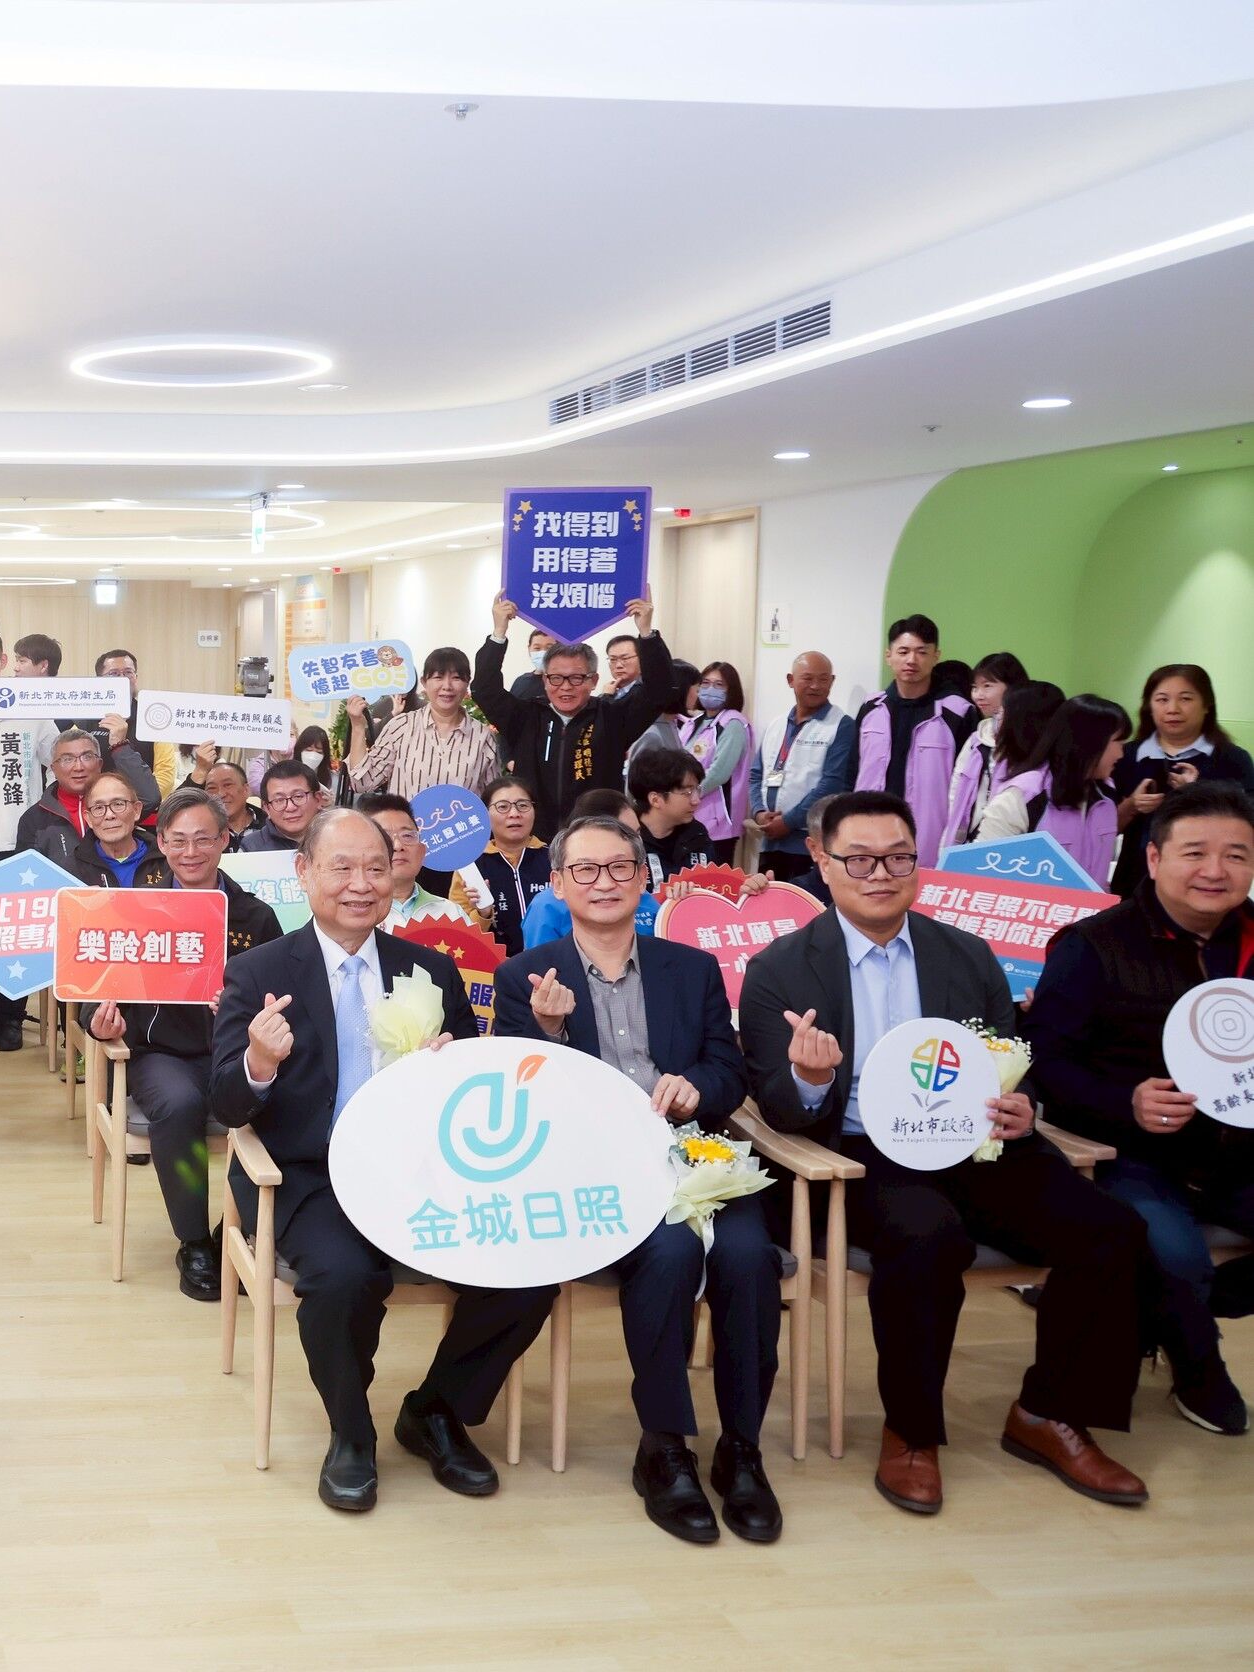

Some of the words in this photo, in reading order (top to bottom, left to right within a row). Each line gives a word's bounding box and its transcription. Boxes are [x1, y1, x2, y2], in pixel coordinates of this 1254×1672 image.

[533, 511, 619, 537] 找得到
[532, 547, 618, 573] 用得著
[531, 583, 616, 608] 沒煩惱
[302, 648, 379, 678] 失智友善
[18, 690, 116, 700] 新北市政府衛生局
[175, 709, 283, 725] 新北市高齡長期照顧處
[0, 732, 25, 806] 黃承鋒
[76, 930, 204, 964] 樂齡創藝
[891, 1115, 974, 1136] 新北市政府
[407, 1184, 629, 1252] 金城日照
